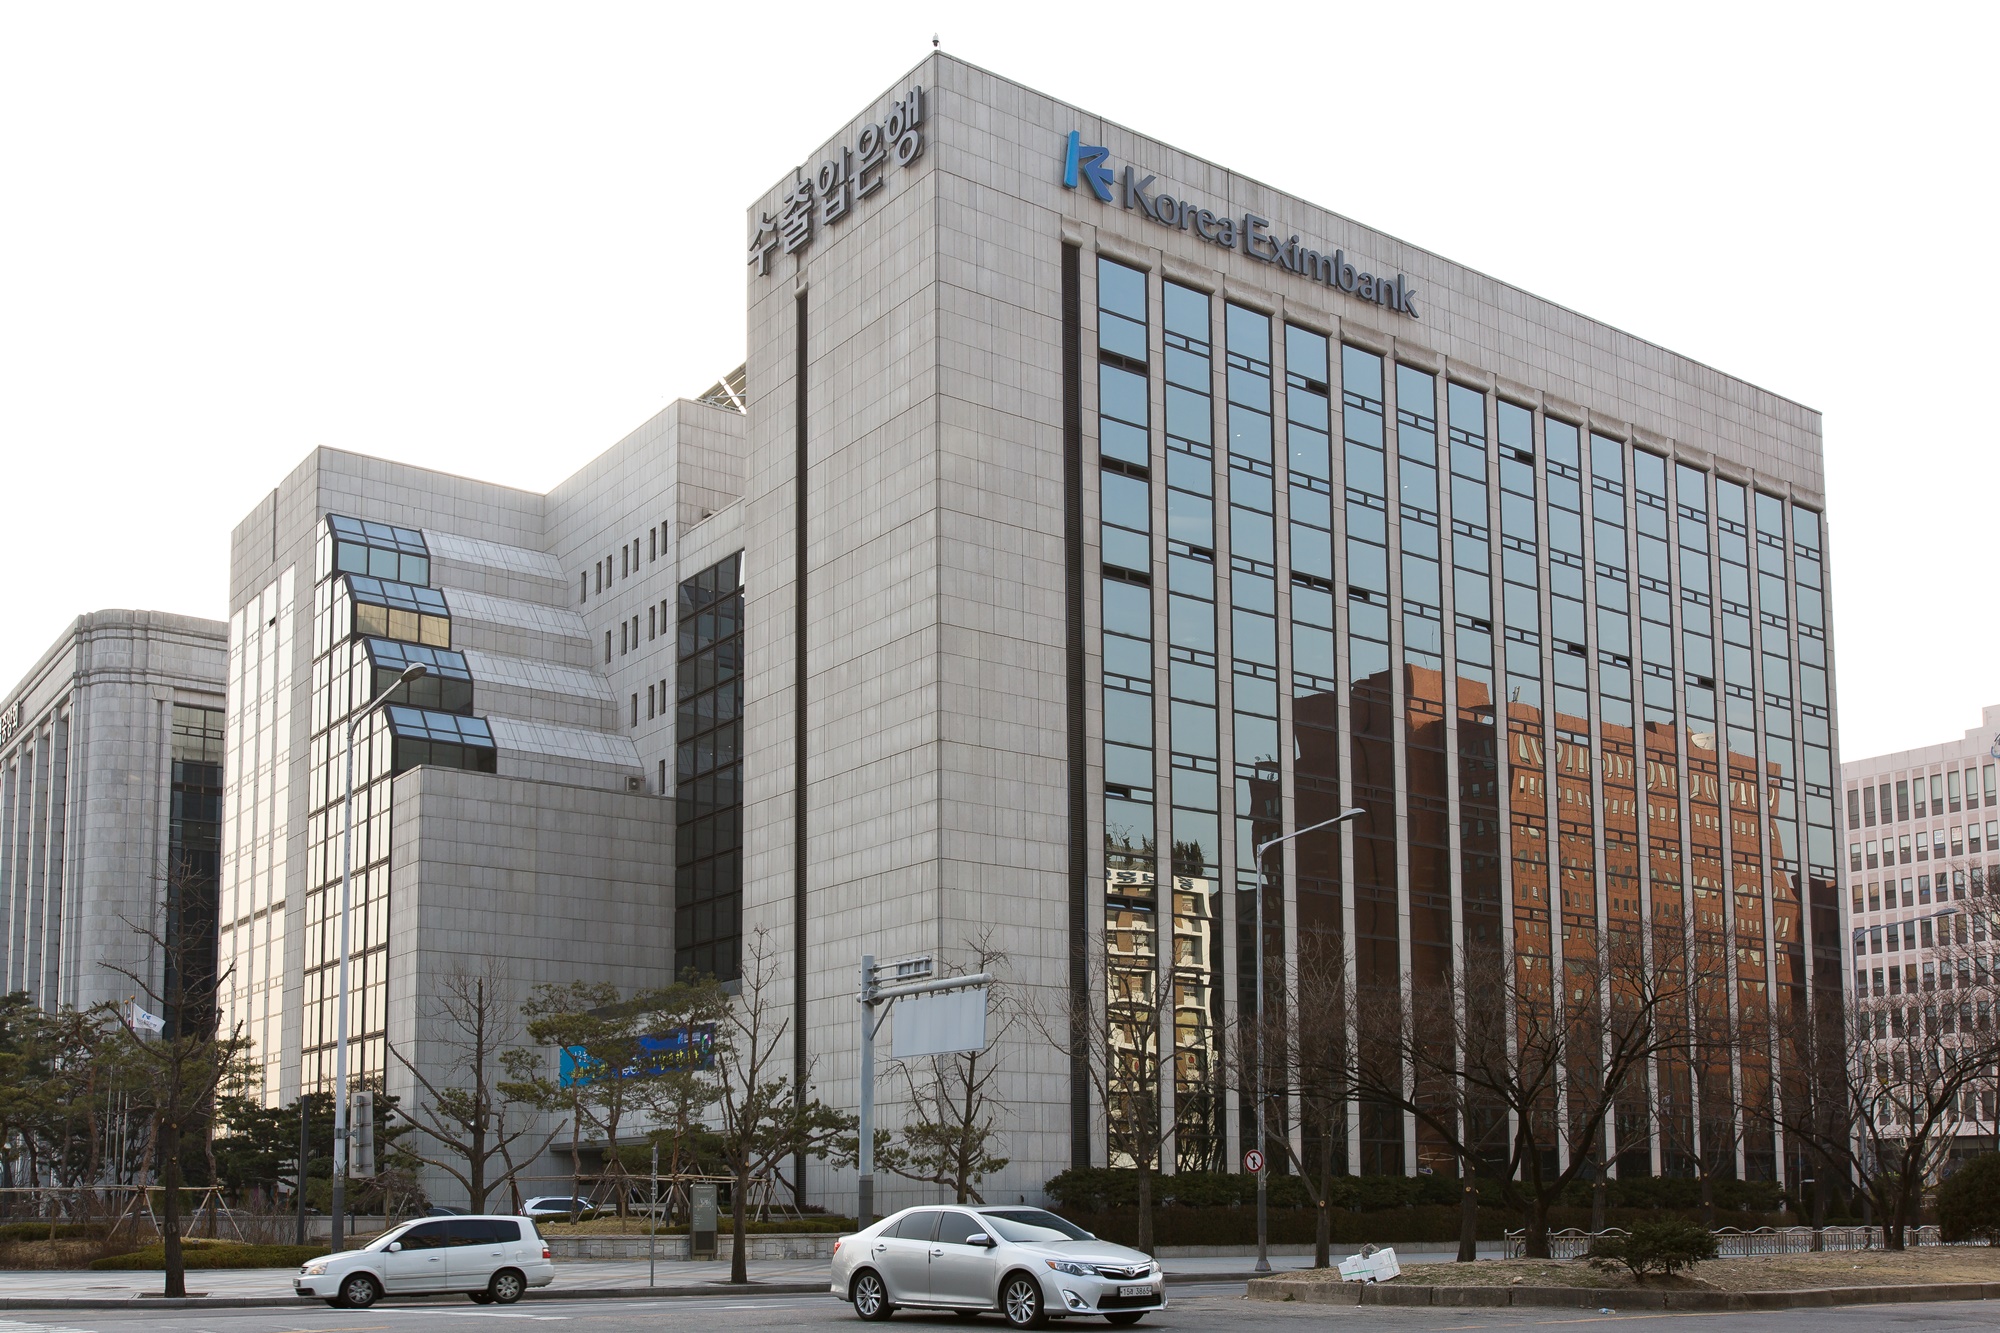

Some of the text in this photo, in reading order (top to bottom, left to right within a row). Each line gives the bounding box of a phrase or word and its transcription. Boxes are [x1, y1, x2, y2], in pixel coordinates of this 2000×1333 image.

[747, 84, 923, 277] 수출입은행
[1124, 165, 1419, 318] Korea Eximbank
[0, 701, 20, 746] 중앙회
